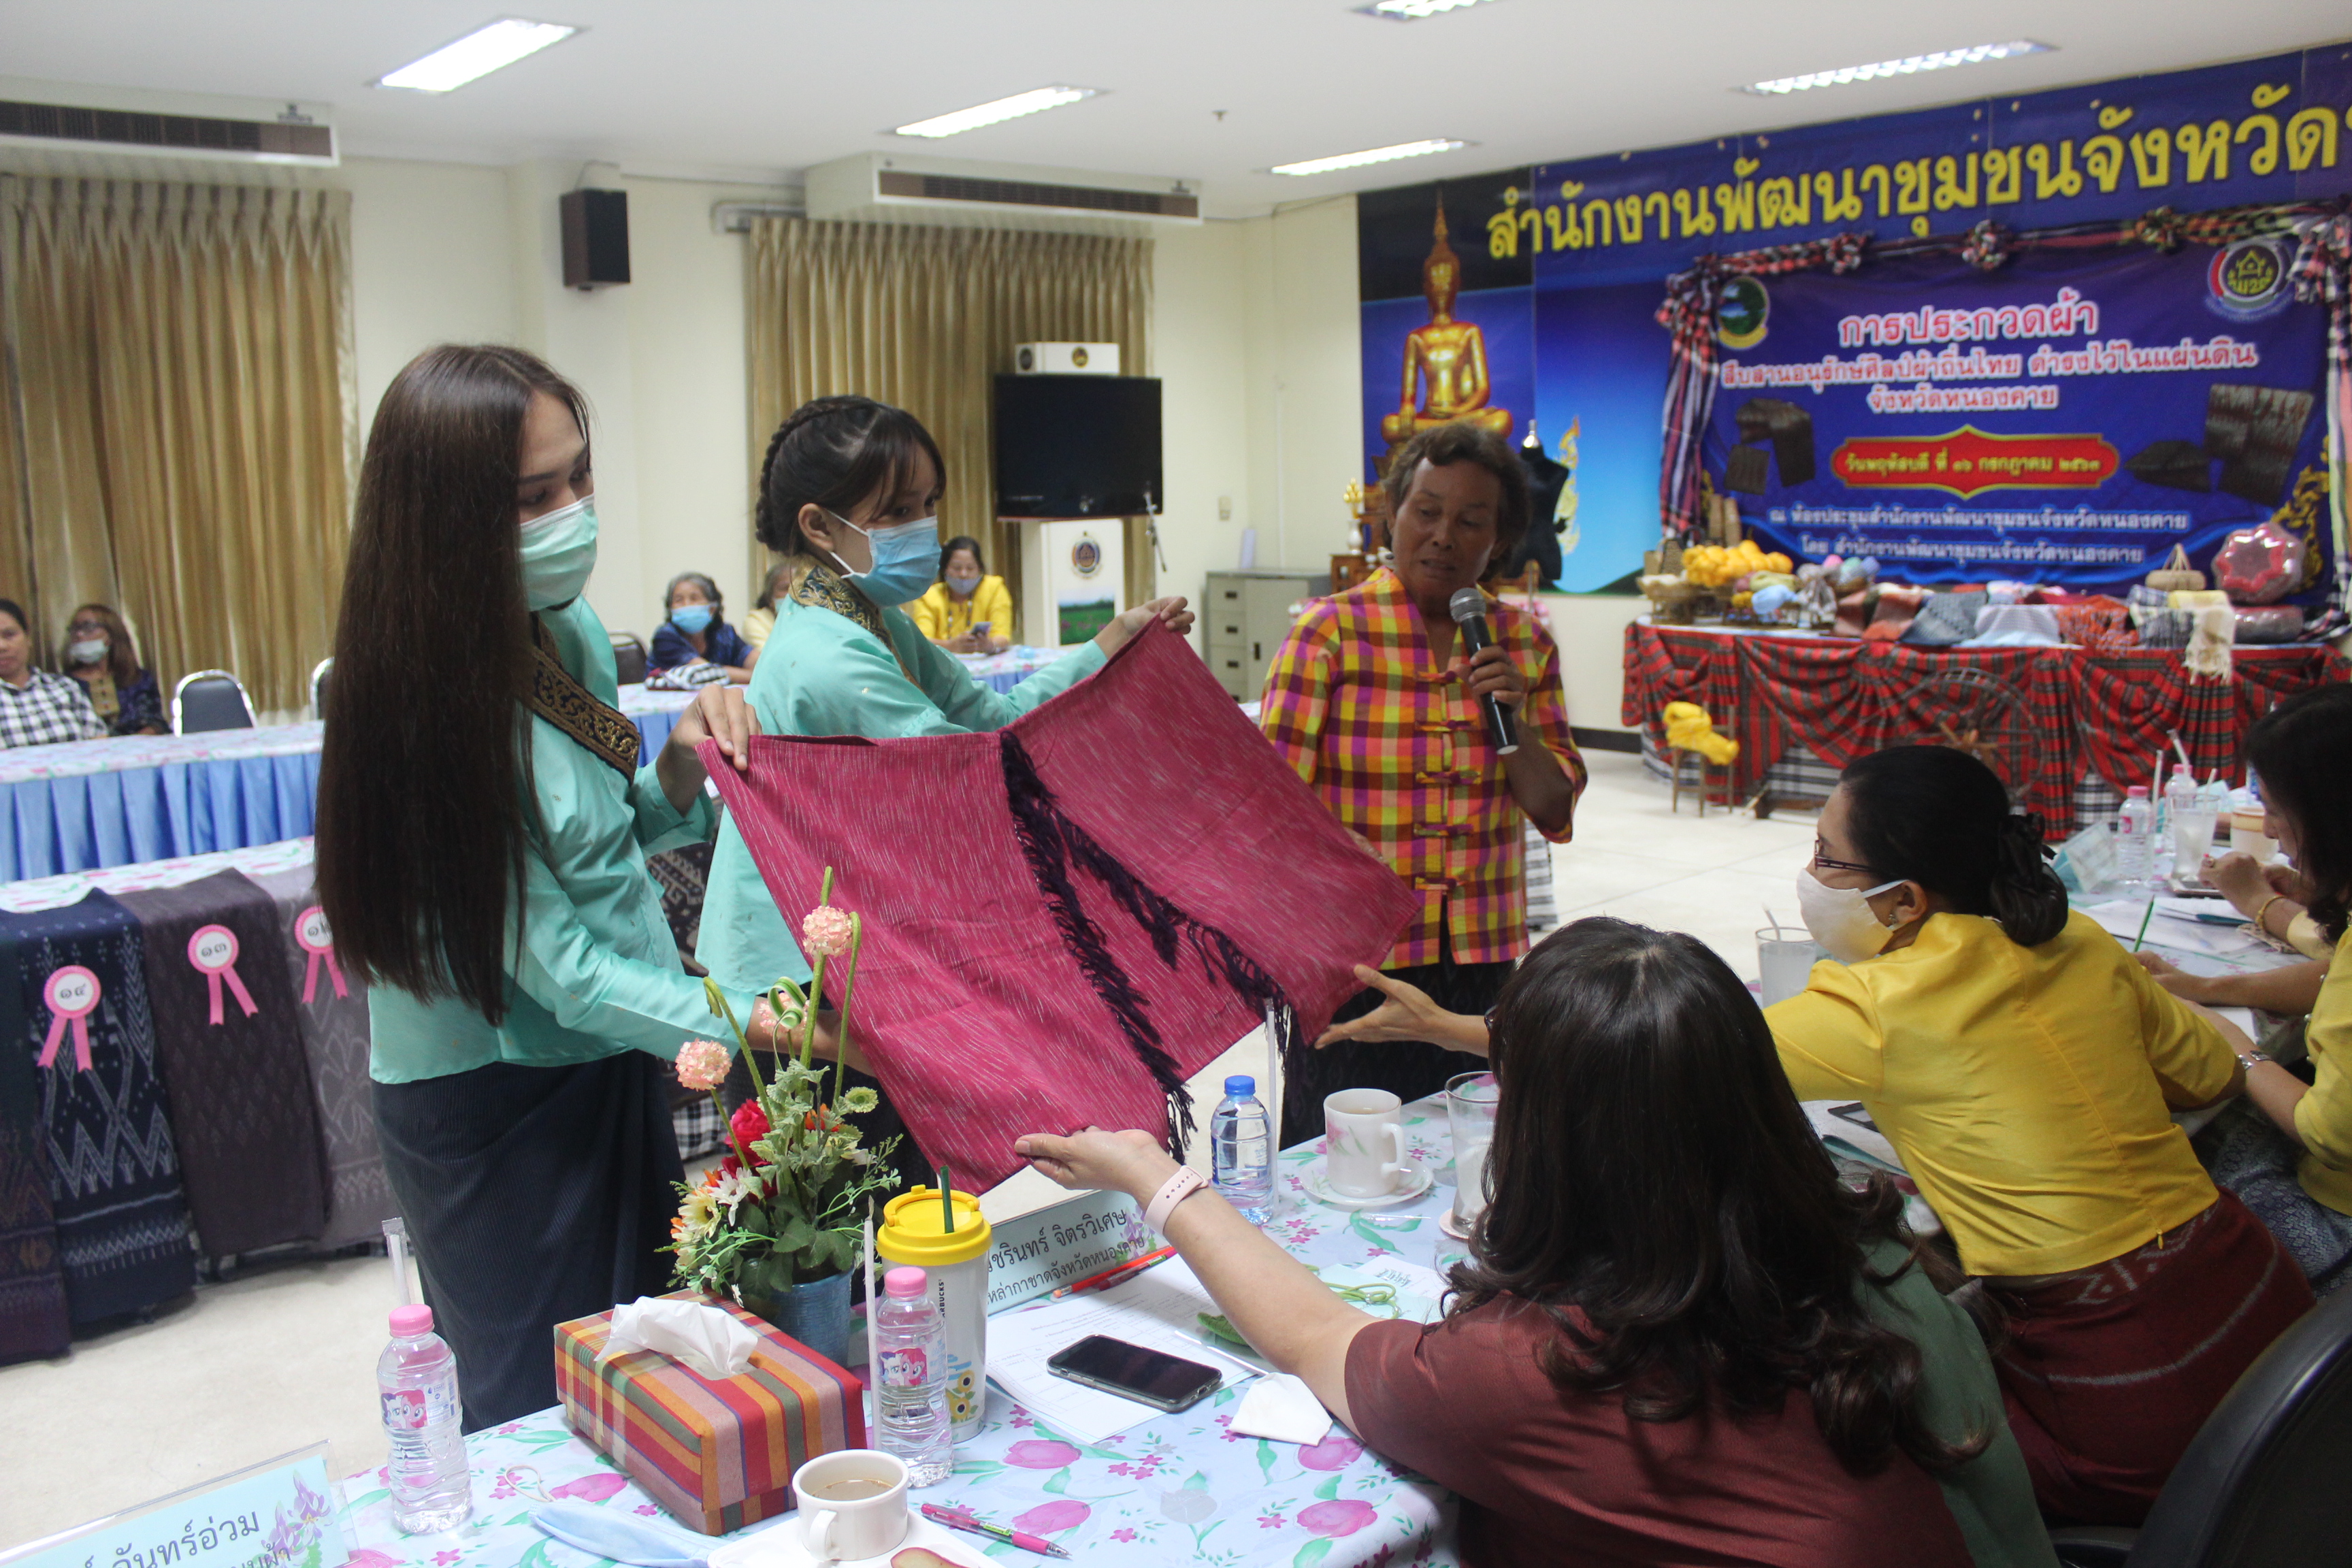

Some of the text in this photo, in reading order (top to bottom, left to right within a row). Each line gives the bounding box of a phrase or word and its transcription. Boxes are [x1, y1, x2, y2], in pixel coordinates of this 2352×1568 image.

[1486, 82, 2352, 259] สำนักงานพัฒนาชุมชนจังหวัด
[1840, 287, 2097, 347] การประกวดผ้า
[2028, 336, 2259, 376] ดำรงไว้ในแผ่นดิน
[1867, 383, 2059, 413] จังหวัดหนองคาย
[1052, 1209, 1127, 1247] จิตรวิเศษ
[987, 1237, 1145, 1305] หล่ากาชาดจังหวัดหนองคาย
